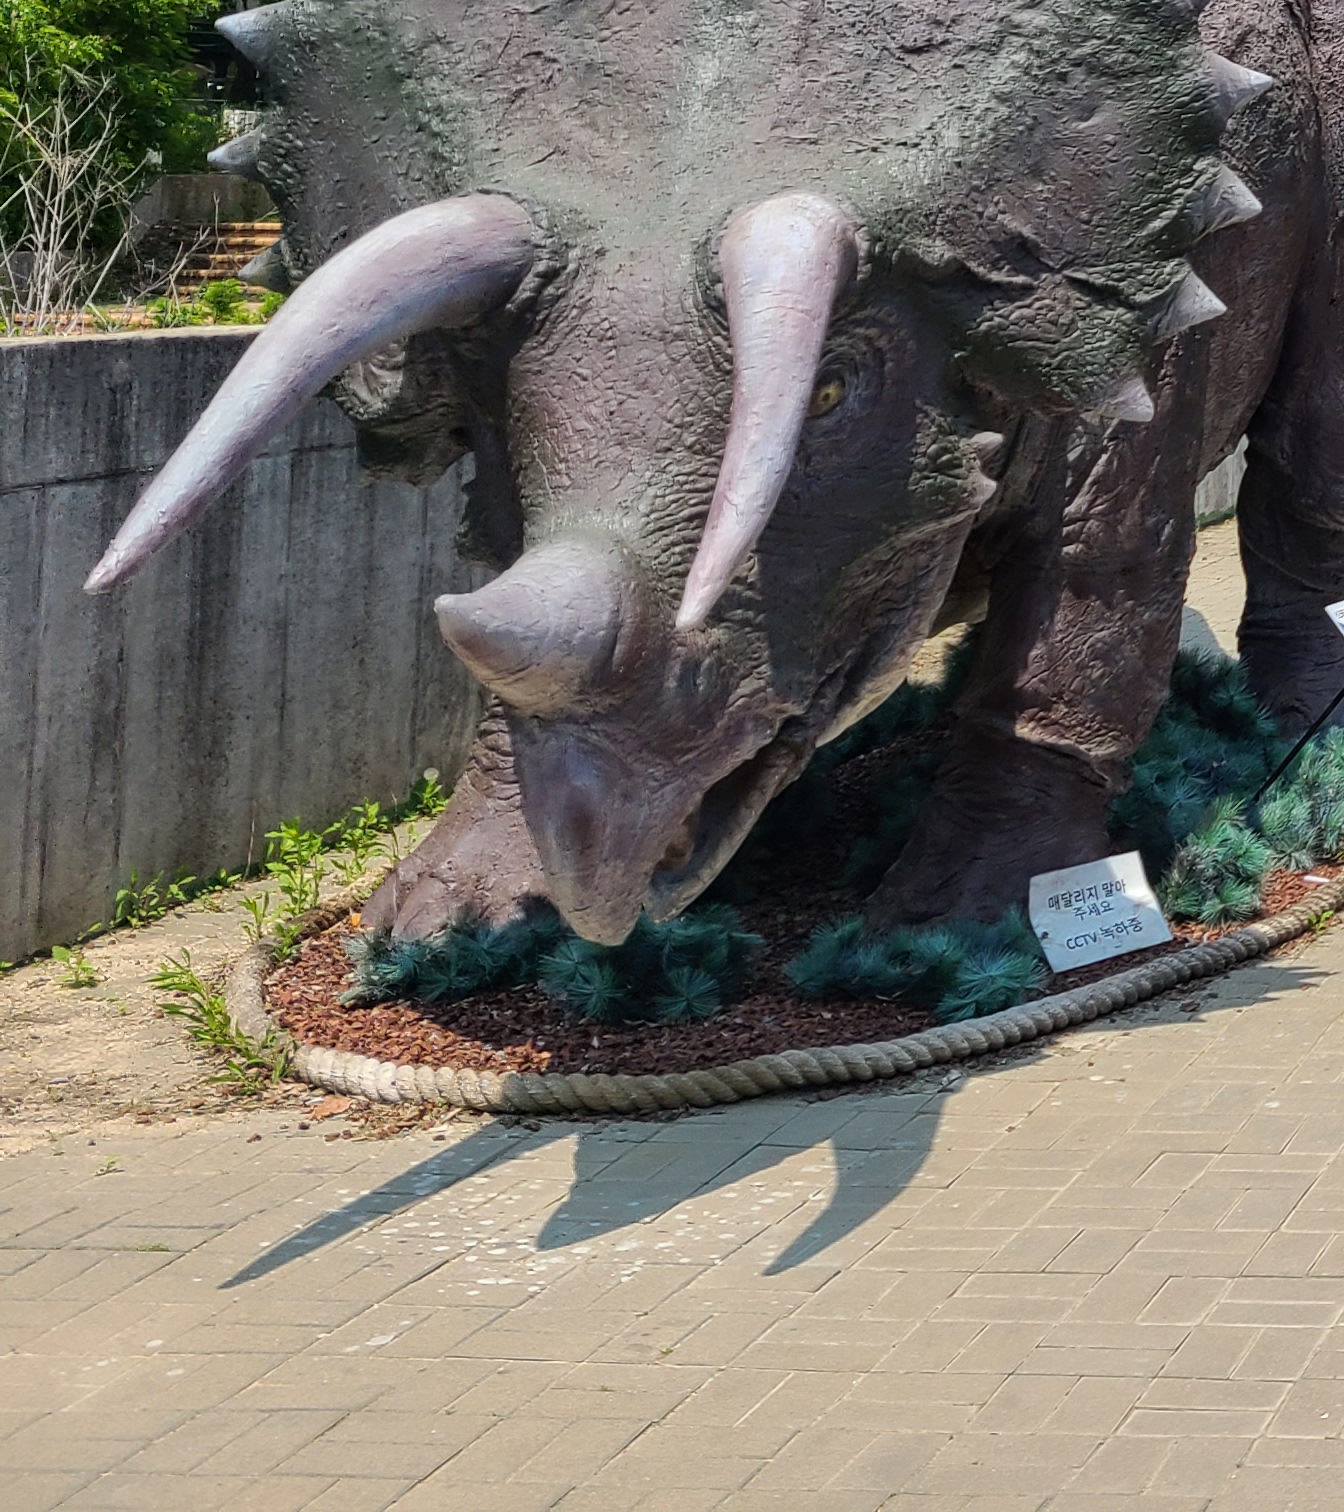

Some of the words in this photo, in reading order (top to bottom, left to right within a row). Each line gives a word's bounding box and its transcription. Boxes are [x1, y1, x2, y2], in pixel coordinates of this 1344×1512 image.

[1048, 885, 1099, 910] 매달리지
[1102, 879, 1127, 897] 말아
[1073, 901, 1114, 921] 주세요
[1066, 932, 1097, 950] CCTV
